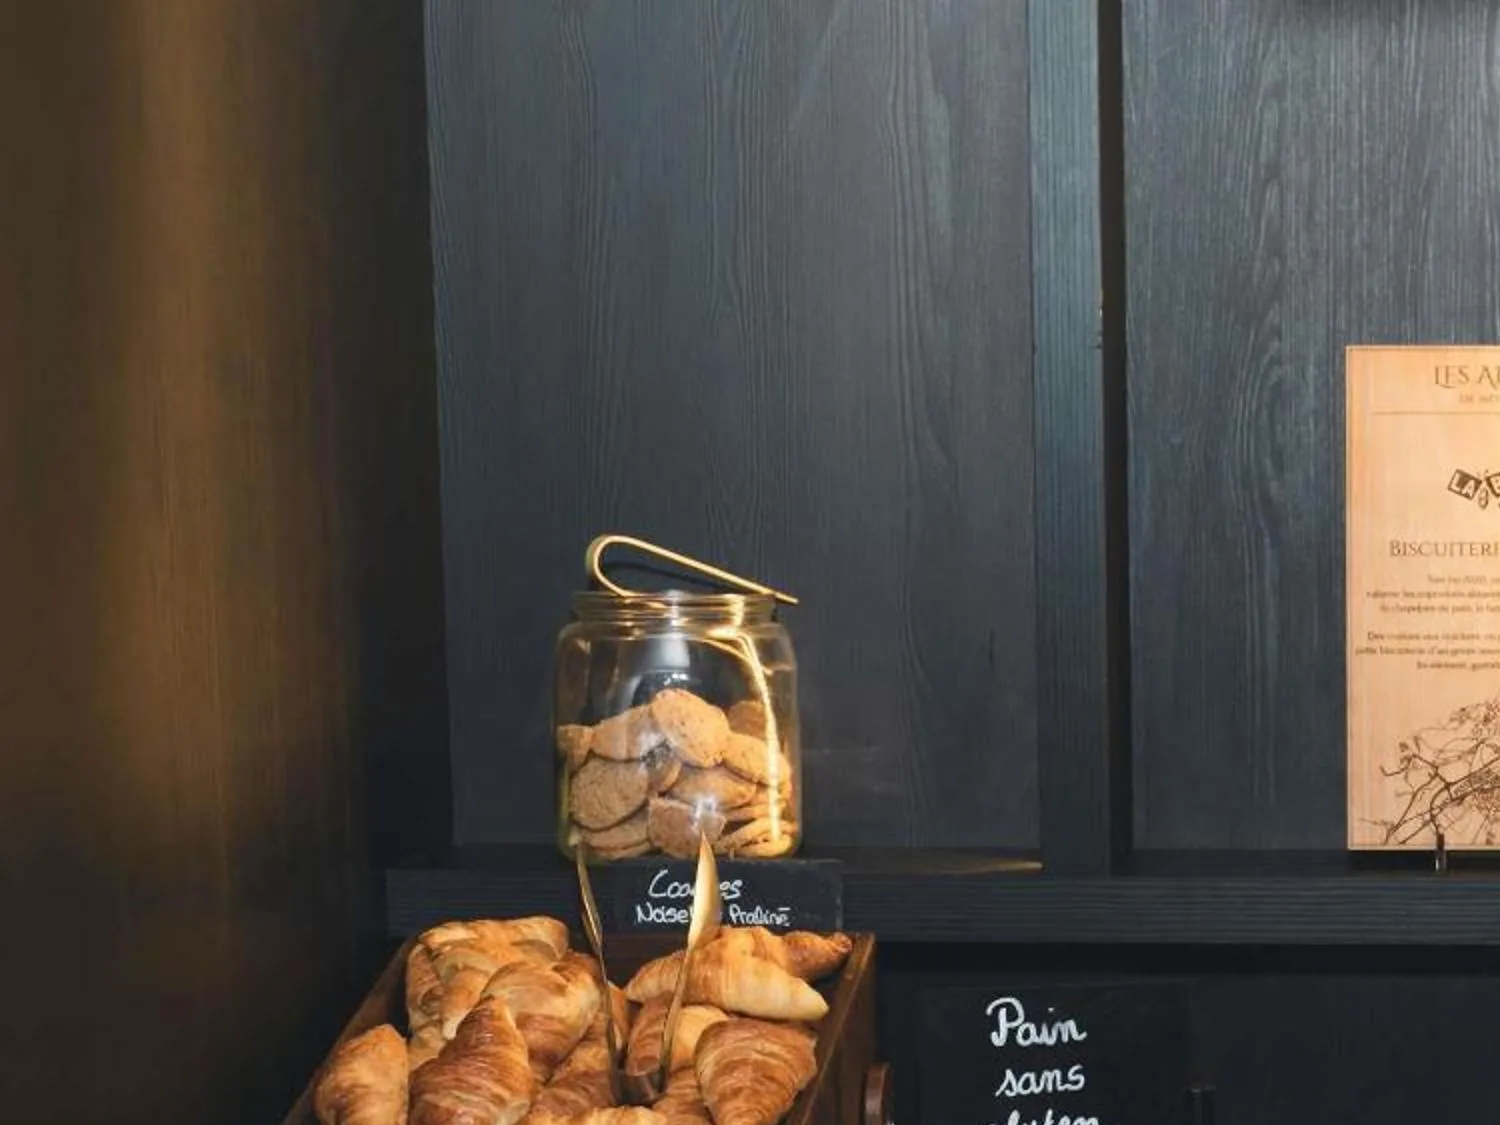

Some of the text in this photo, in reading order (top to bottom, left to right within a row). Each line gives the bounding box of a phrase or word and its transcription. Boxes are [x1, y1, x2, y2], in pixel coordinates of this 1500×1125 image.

[1434, 366, 1470, 388] LES
[1449, 473, 1477, 499] LA
[648, 869, 743, 900] Cooes
[985, 997, 1087, 1047] Pain
[995, 1064, 1086, 1097] sans
